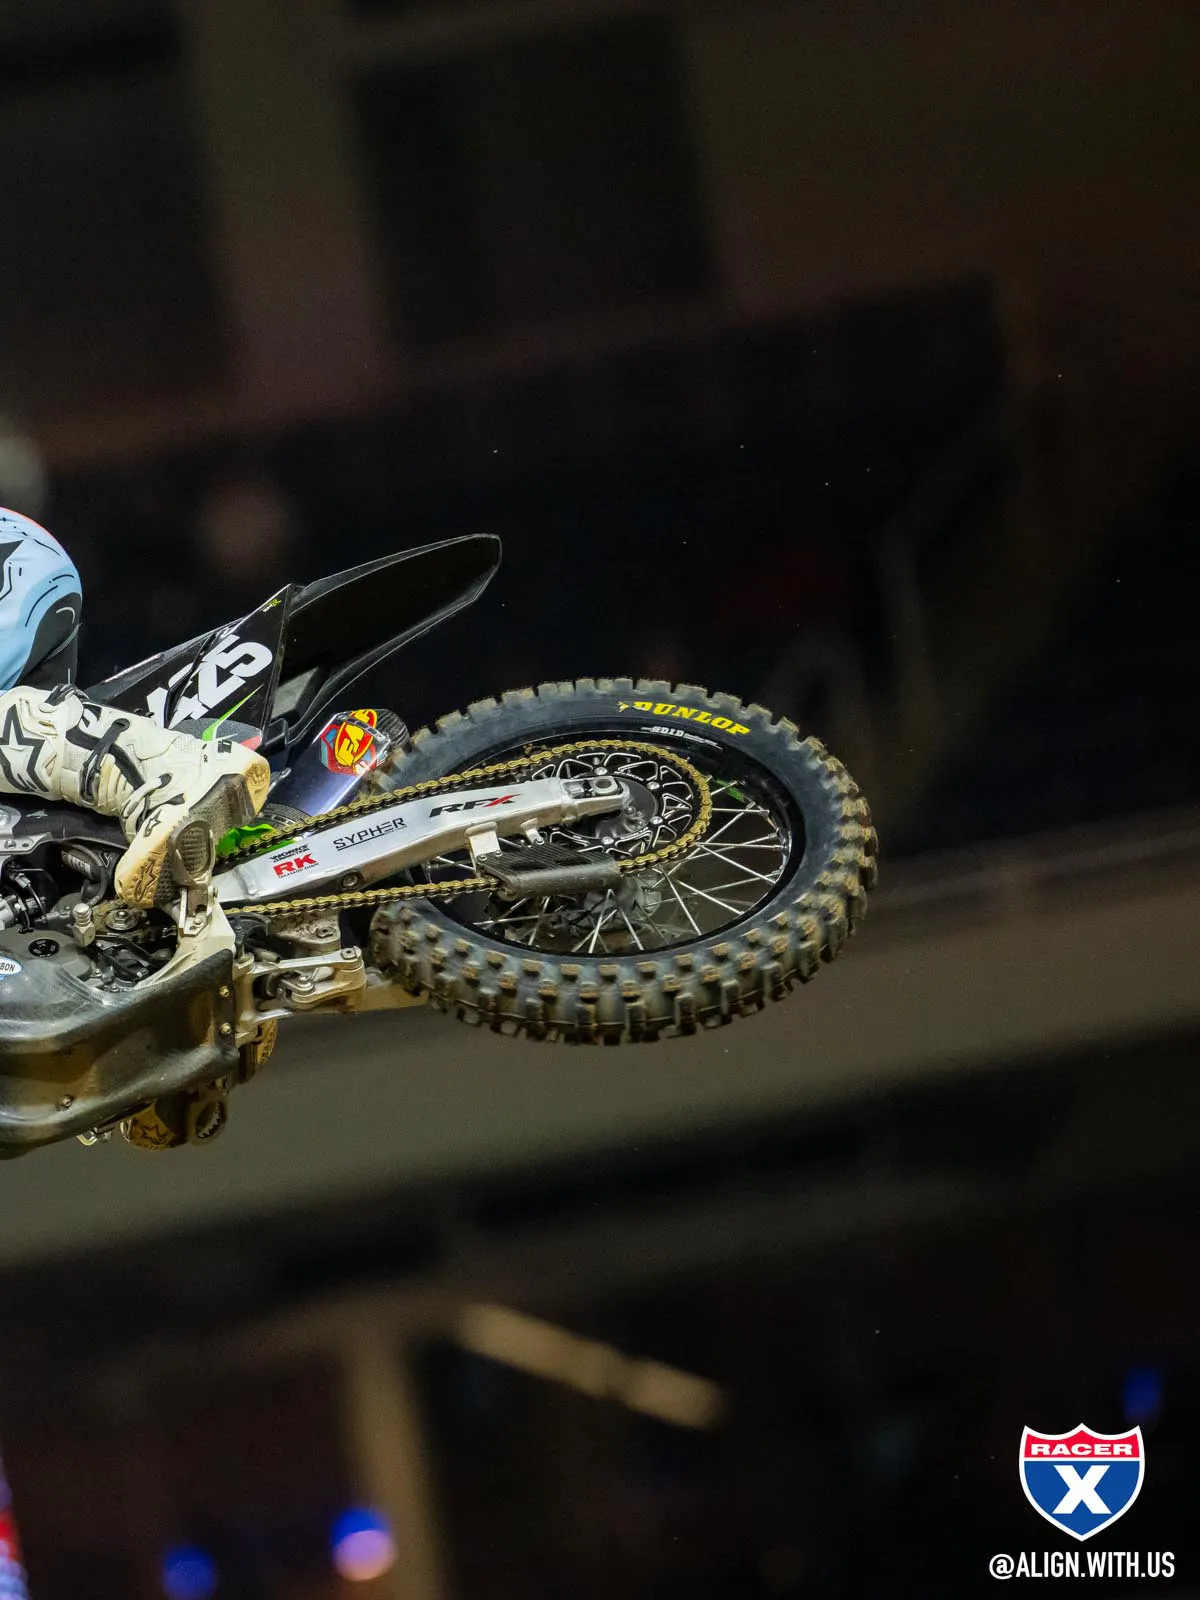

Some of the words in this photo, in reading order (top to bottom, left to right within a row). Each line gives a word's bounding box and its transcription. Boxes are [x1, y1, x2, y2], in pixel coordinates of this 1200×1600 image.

[633, 701, 750, 736] DUNLOP
[429, 793, 521, 818] RFX
[333, 817, 406, 849] SYPHER
[273, 853, 317, 876] RK
